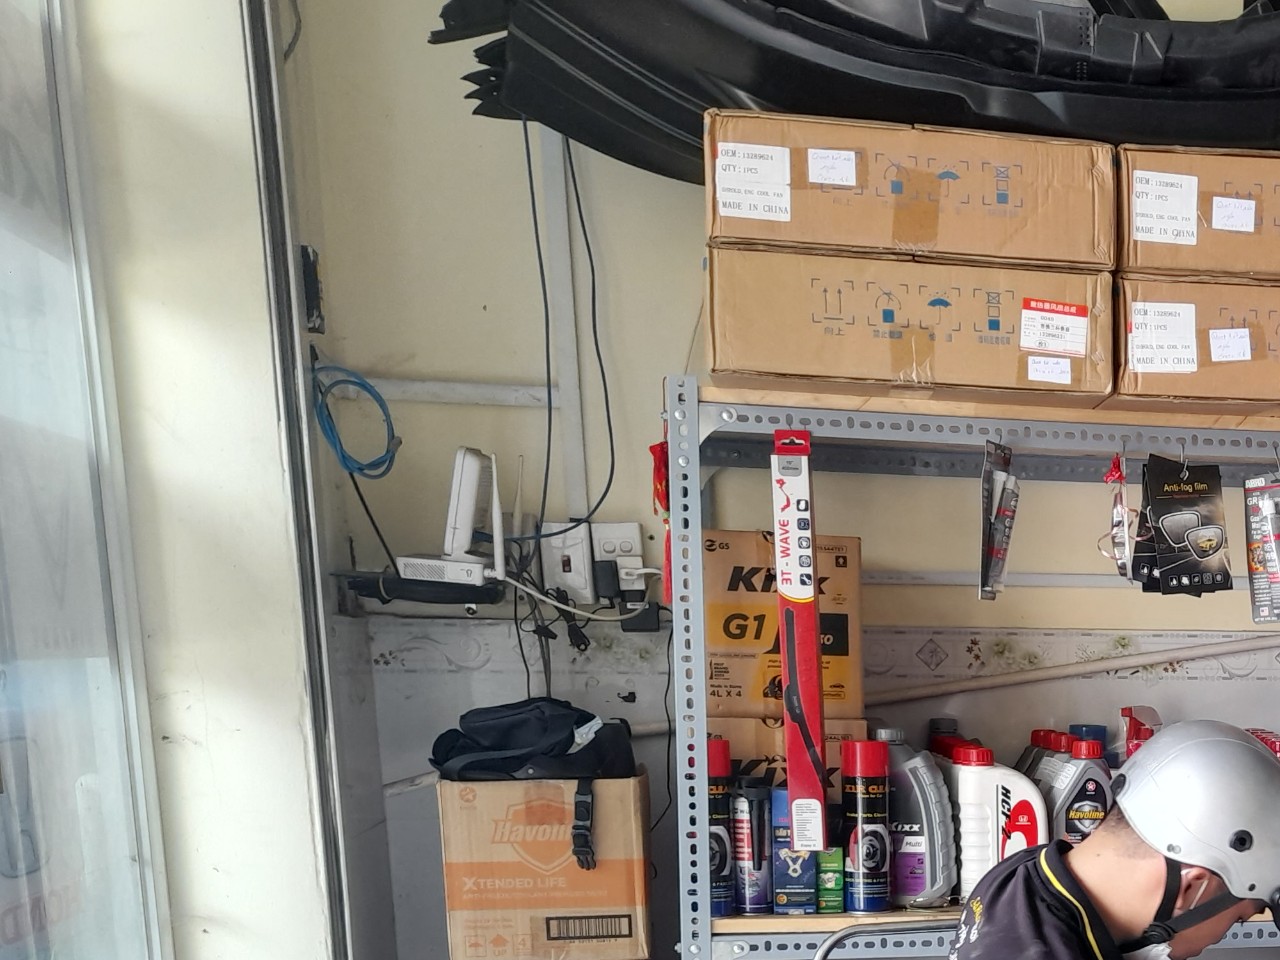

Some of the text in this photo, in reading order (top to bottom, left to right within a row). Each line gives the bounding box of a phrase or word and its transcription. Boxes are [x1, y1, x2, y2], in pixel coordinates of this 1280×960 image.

[722, 201, 789, 214] MADE IN CHINA
[1135, 226, 1195, 239] MADE IN CHINA
[1137, 357, 1155, 365] MADE
[1164, 483, 1208, 492] Anti-fog film
[719, 542, 730, 550] GS
[779, 519, 792, 586] 3T WAVE
[723, 612, 766, 640] G1
[710, 690, 723, 698] 4L
[736, 690, 742, 698] 4
[1069, 810, 1105, 819] Havoline
[462, 877, 567, 891] XTENDED LIFE
